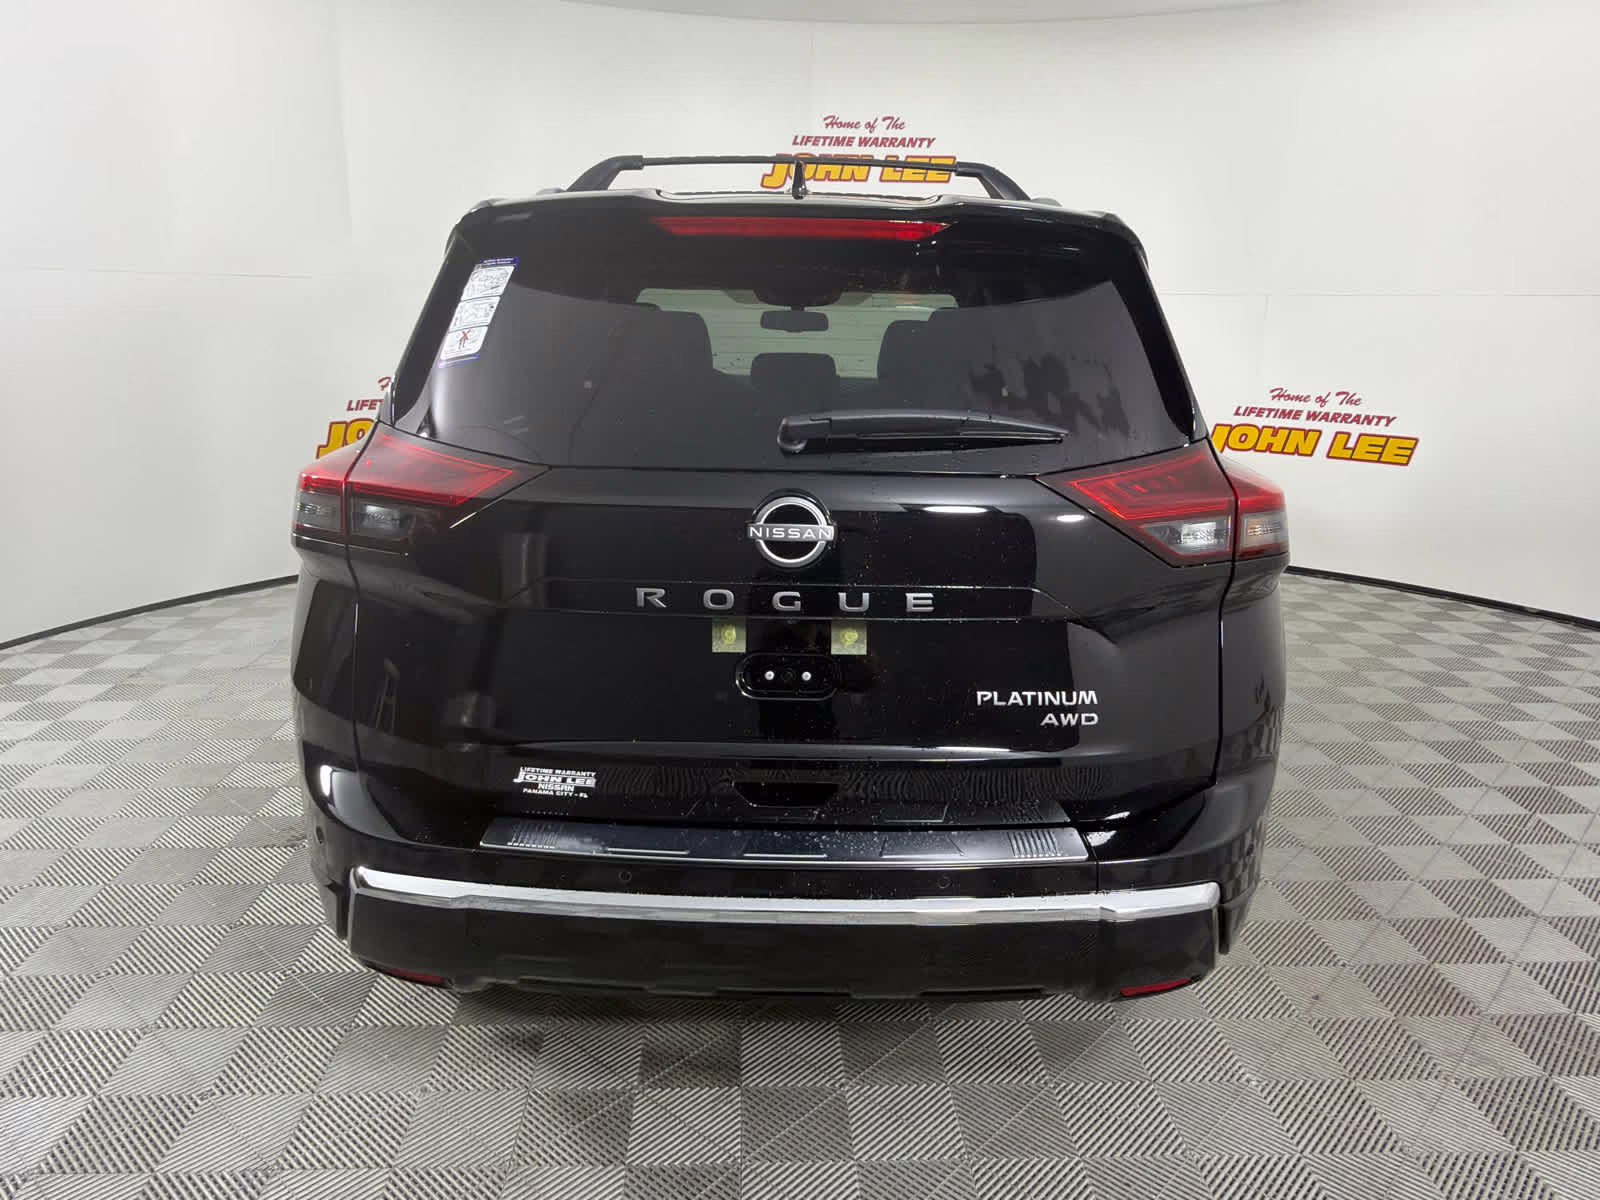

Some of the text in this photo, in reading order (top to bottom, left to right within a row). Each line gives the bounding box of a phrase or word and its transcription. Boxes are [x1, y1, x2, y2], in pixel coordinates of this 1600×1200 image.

[823, 115, 906, 133] Home of The
[792, 135, 936, 149] LIFETIME WARRANTY
[879, 155, 957, 183] LEE
[1269, 387, 1363, 408] Home of The
[1233, 406, 1397, 427] LIFETIME WARRANTY
[1326, 431, 1419, 466] LEE
[749, 525, 834, 539] NISSAN
[635, 587, 935, 612] ROGUE
[976, 690, 1098, 706] PLATINUM
[1040, 713, 1099, 727] AWD
[513, 771, 597, 788] JOHN LEE
[520, 766, 597, 777] LIFETIME WARRANTY
[522, 788, 554, 796] PANAMA
[556, 790, 574, 798] CITY
[538, 783, 575, 792] NISSAN
